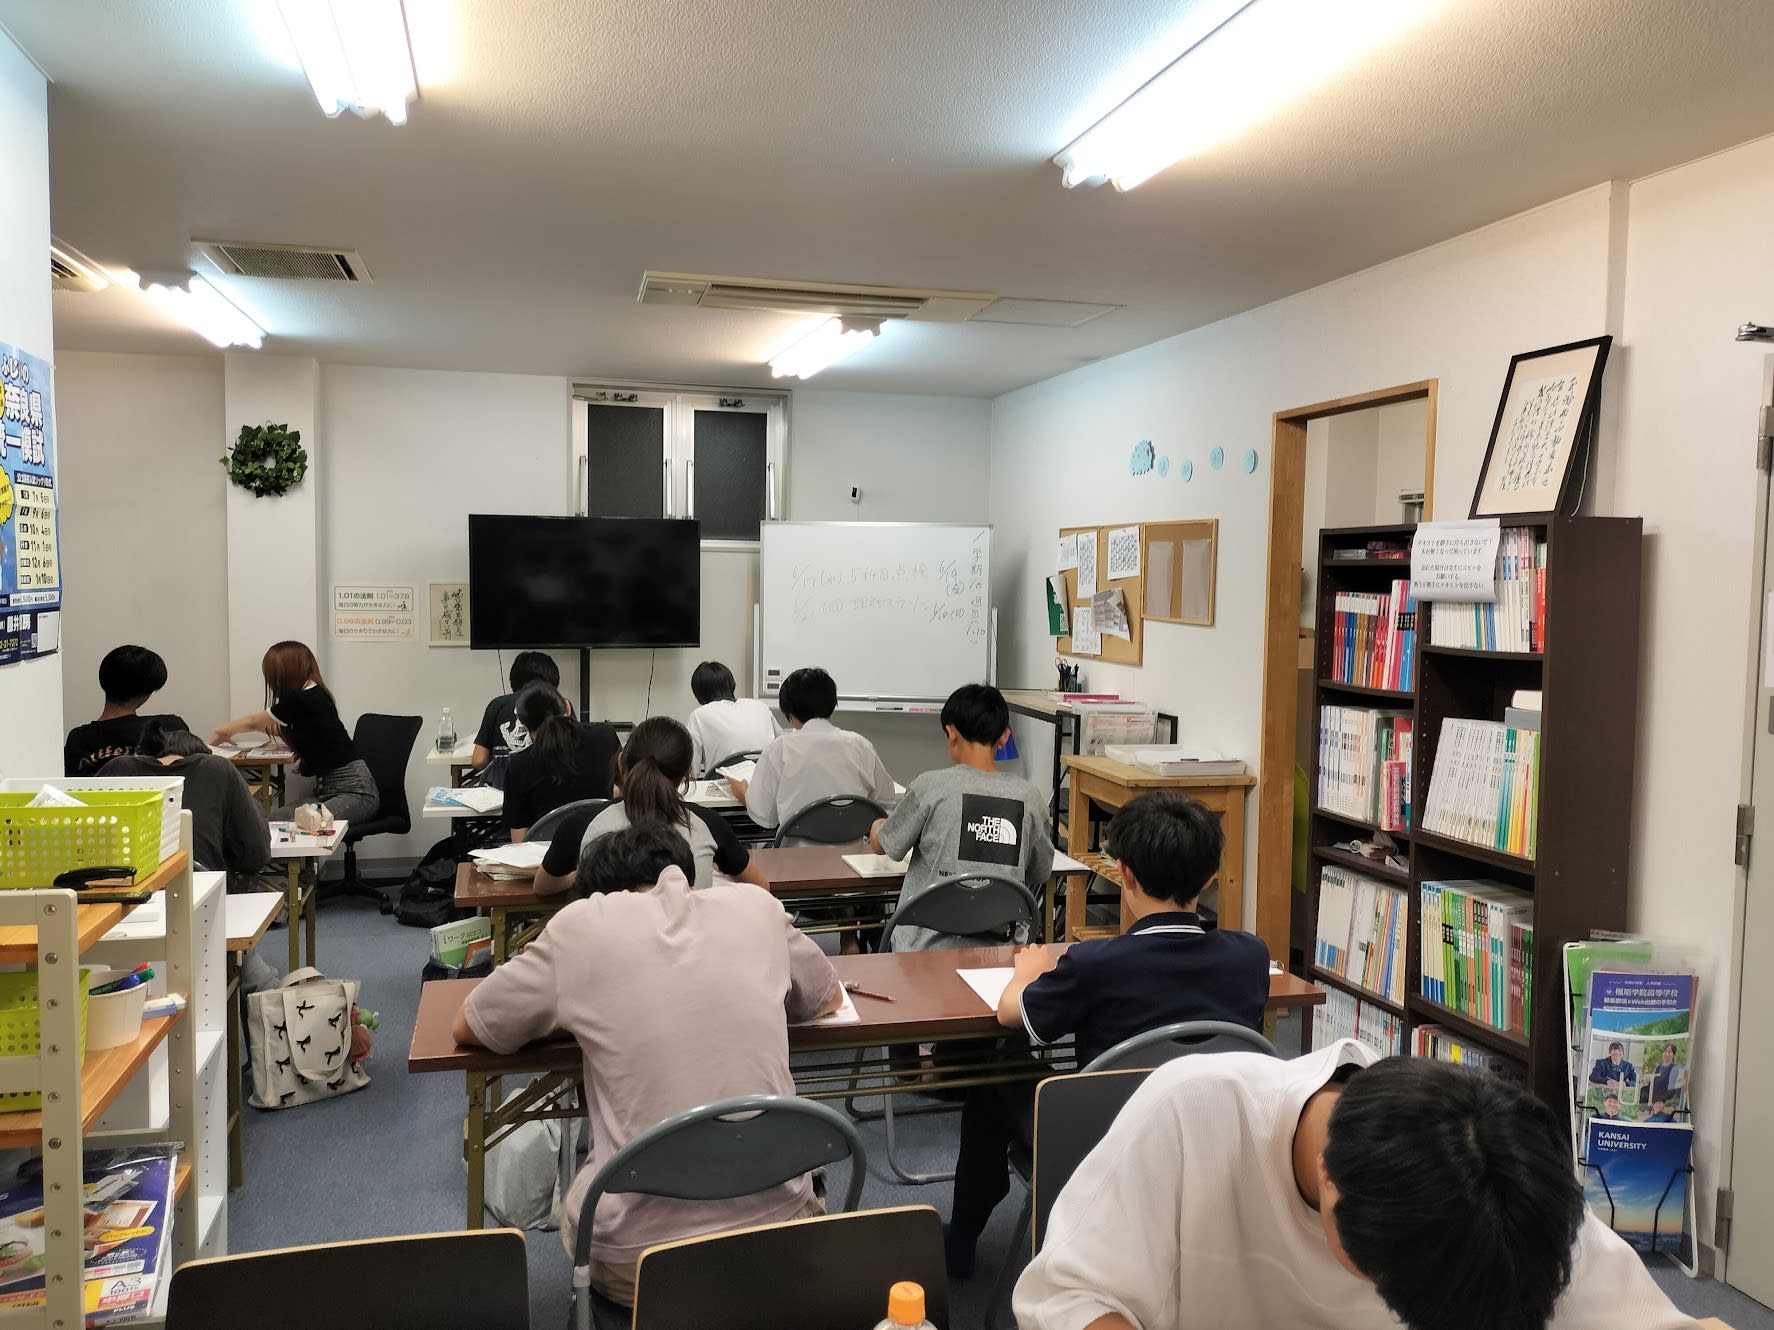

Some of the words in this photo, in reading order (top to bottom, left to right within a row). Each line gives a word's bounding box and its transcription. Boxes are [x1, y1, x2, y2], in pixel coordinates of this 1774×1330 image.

[982, 815, 1001, 826] THE
[967, 822, 1000, 834] NORTH
[975, 833, 1000, 844] FACE
[1598, 1131, 1630, 1141] KANSAI
[1597, 1139, 1648, 1151] UNIVERSITY
